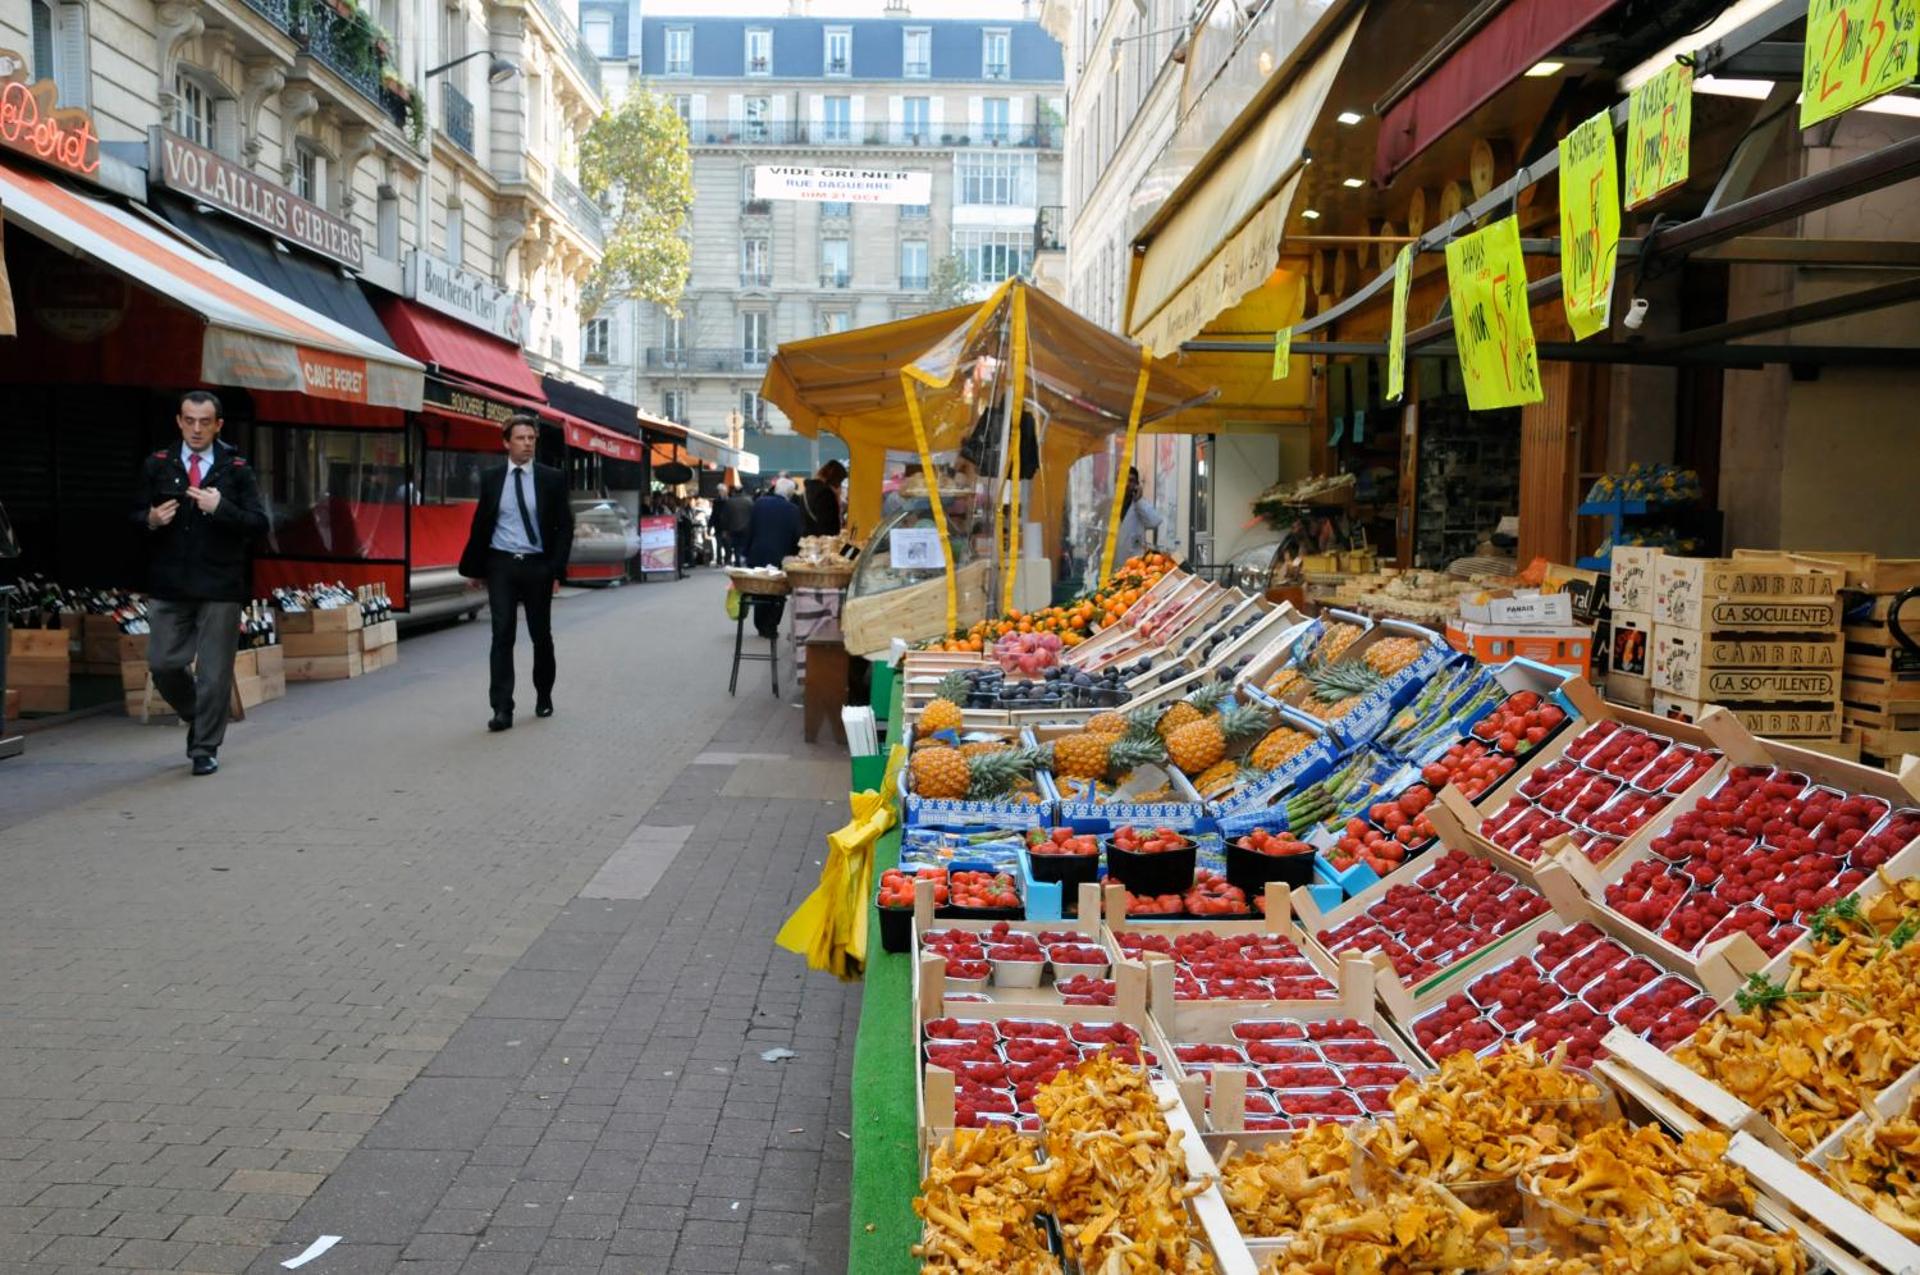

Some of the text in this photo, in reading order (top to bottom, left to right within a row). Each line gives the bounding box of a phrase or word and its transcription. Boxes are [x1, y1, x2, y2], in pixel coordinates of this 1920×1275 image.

[1819, 8, 1847, 102] 2
[1860, 0, 1886, 88] 5
[769, 167, 909, 181] VIDE GRENIER
[786, 179, 892, 191] RUE DAGUERRE
[165, 139, 362, 263] VOLAILLES GIBIERS
[424, 258, 473, 313] Boucheries
[304, 362, 333, 388] CAVE
[334, 369, 364, 394] PERET
[1714, 574, 1834, 596] CAMBRIA
[1717, 607, 1827, 622] LA SOCULENTE
[1713, 643, 1833, 664] CAMBRIA
[1714, 676, 1827, 692] LA SOCULENTE
[1747, 713, 1832, 733] MBRIA
